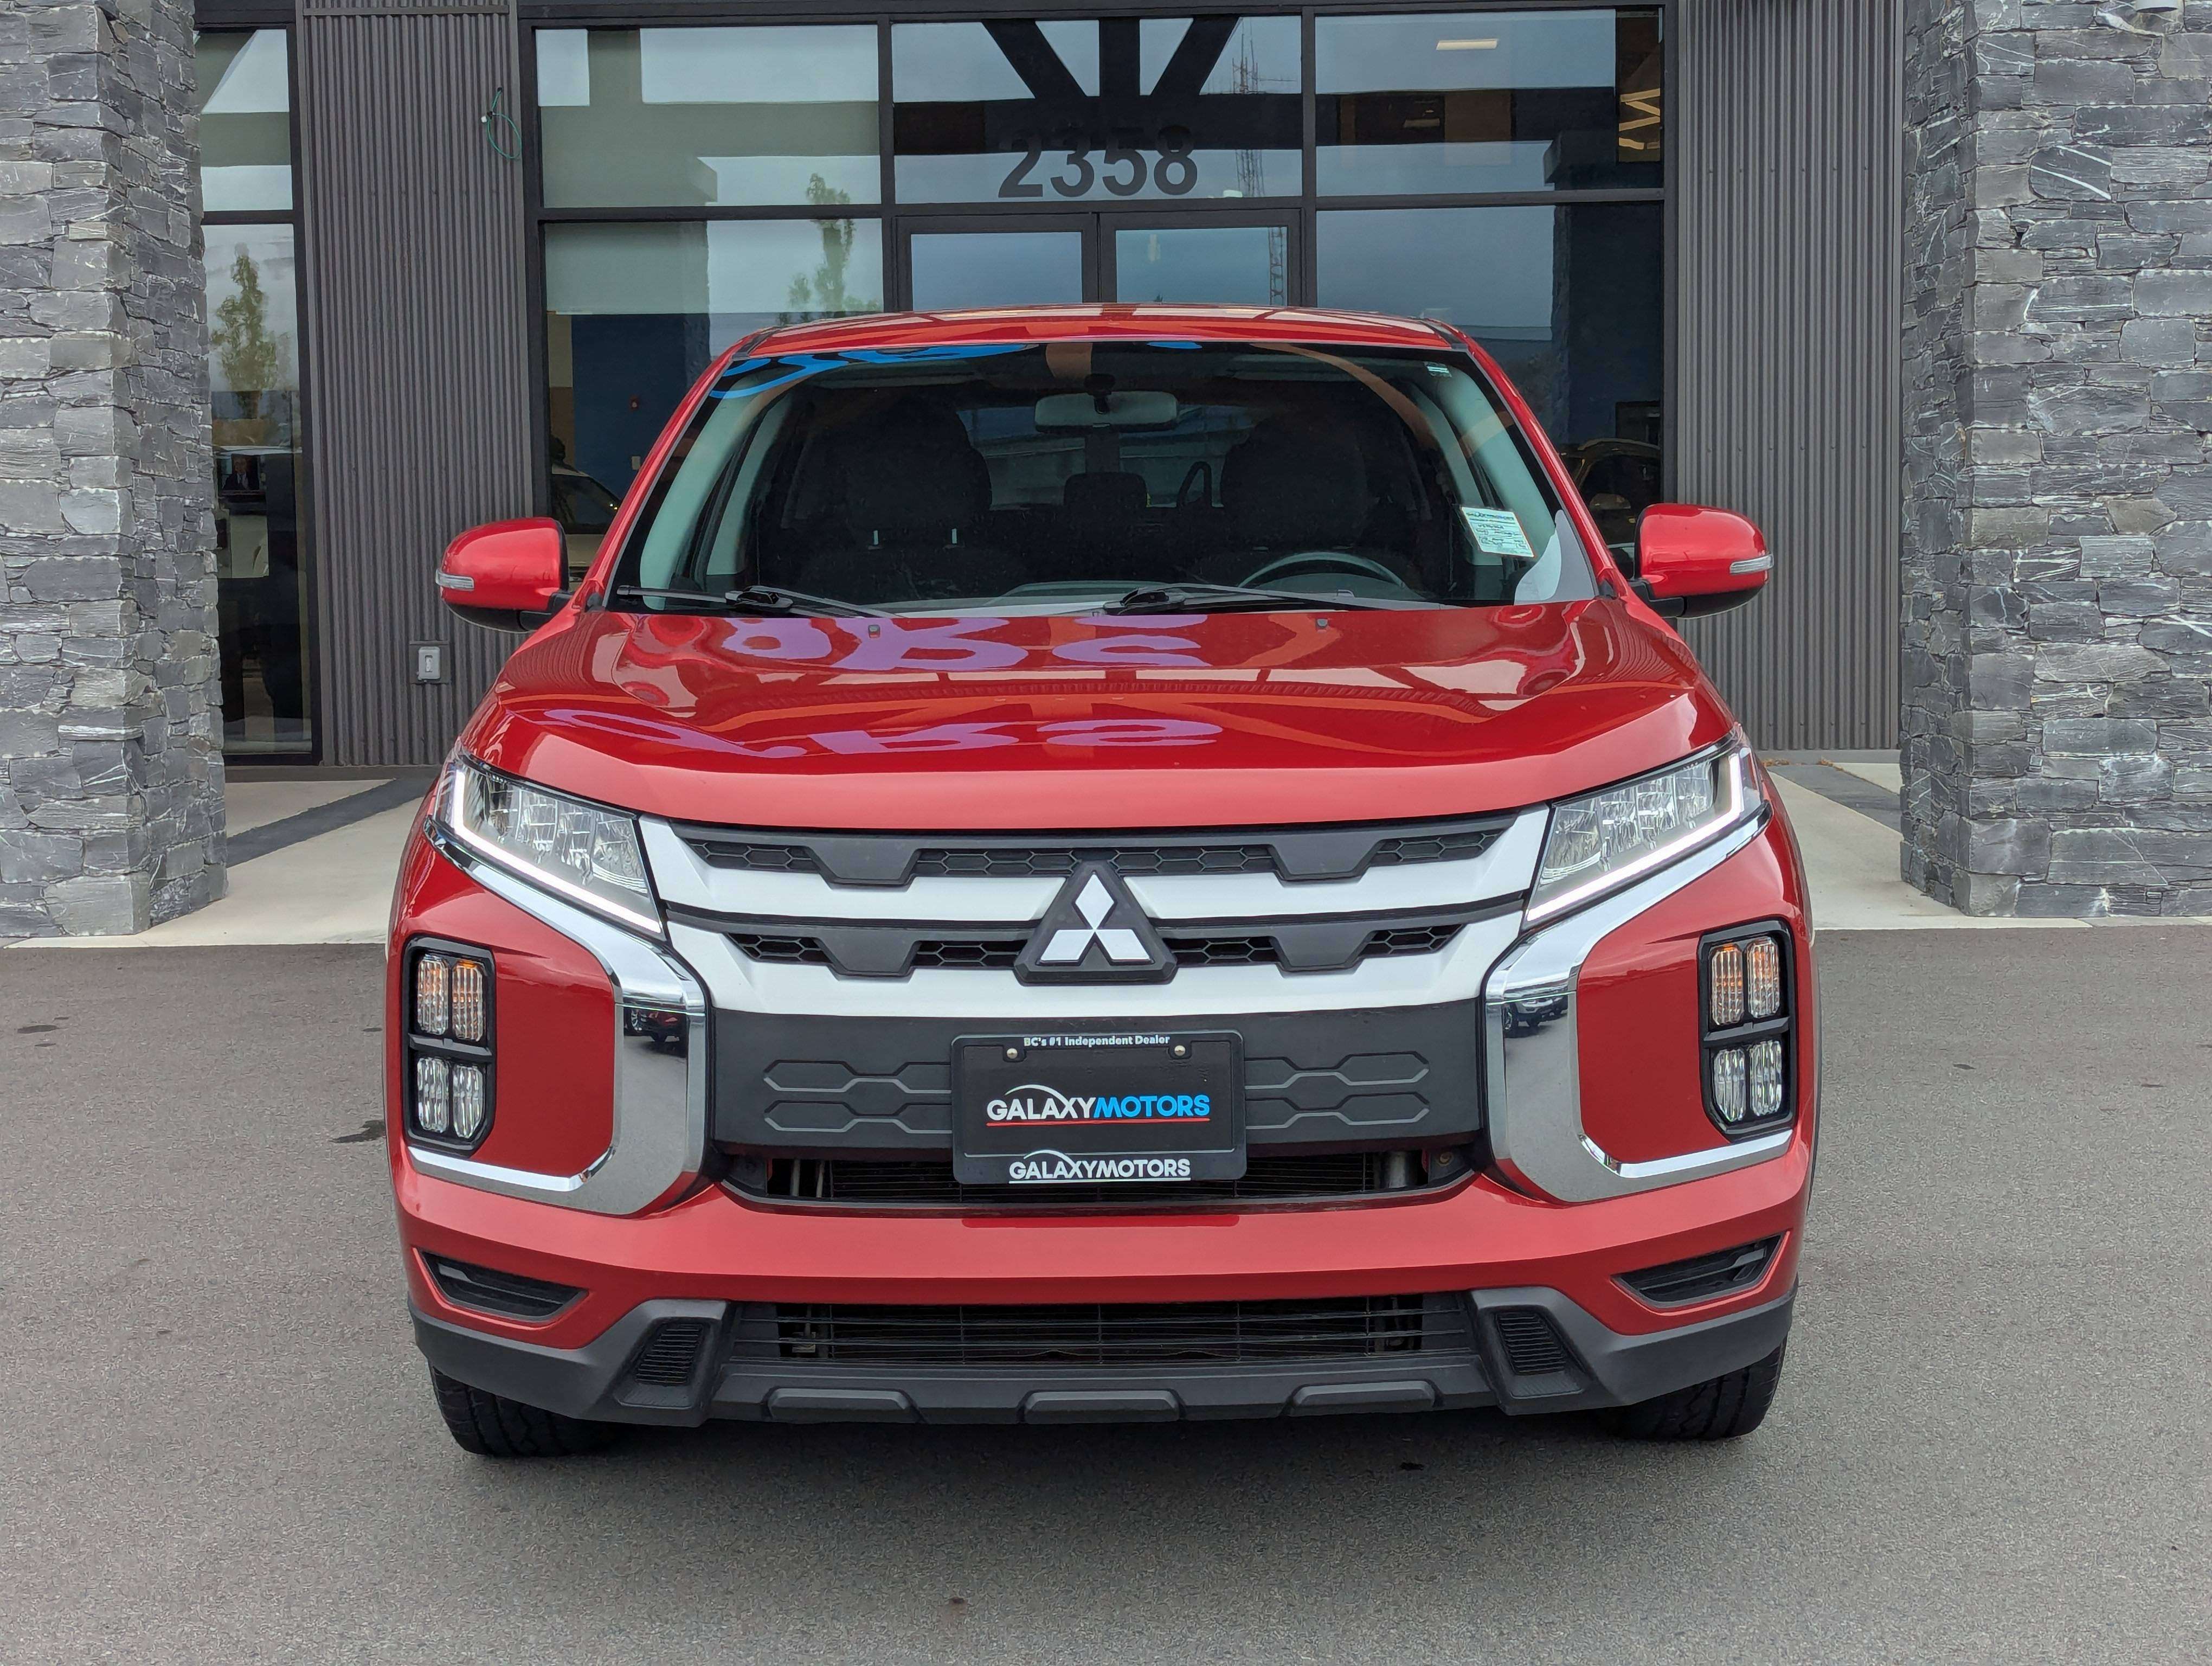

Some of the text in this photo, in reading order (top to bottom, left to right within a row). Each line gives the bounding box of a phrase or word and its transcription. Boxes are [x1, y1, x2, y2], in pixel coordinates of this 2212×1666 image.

[998, 125, 1198, 197] 2358
[1024, 1035, 1170, 1047] BC's #1 Independent Dealer
